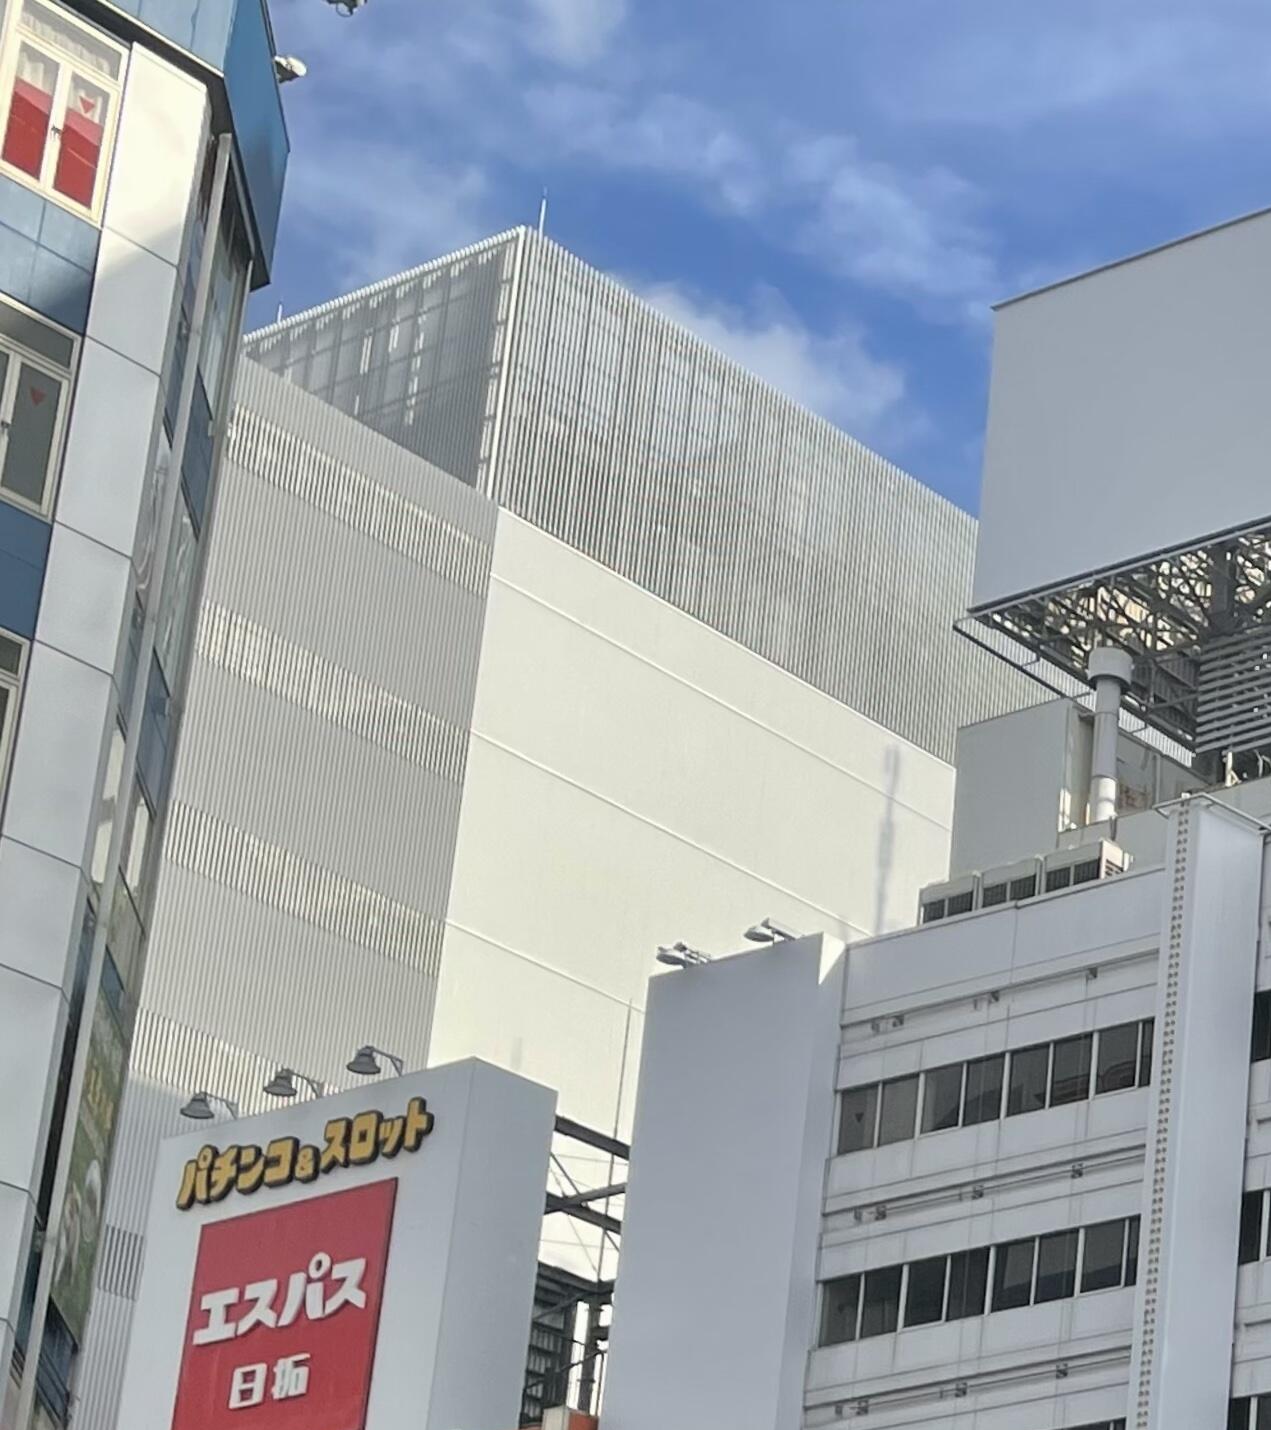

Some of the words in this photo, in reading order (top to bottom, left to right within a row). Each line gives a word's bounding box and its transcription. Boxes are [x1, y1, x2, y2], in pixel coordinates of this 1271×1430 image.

[177, 1097, 435, 1210] パチンコ&スロット
[192, 1251, 368, 1346] エスパス
[227, 1352, 312, 1410] 日拓
